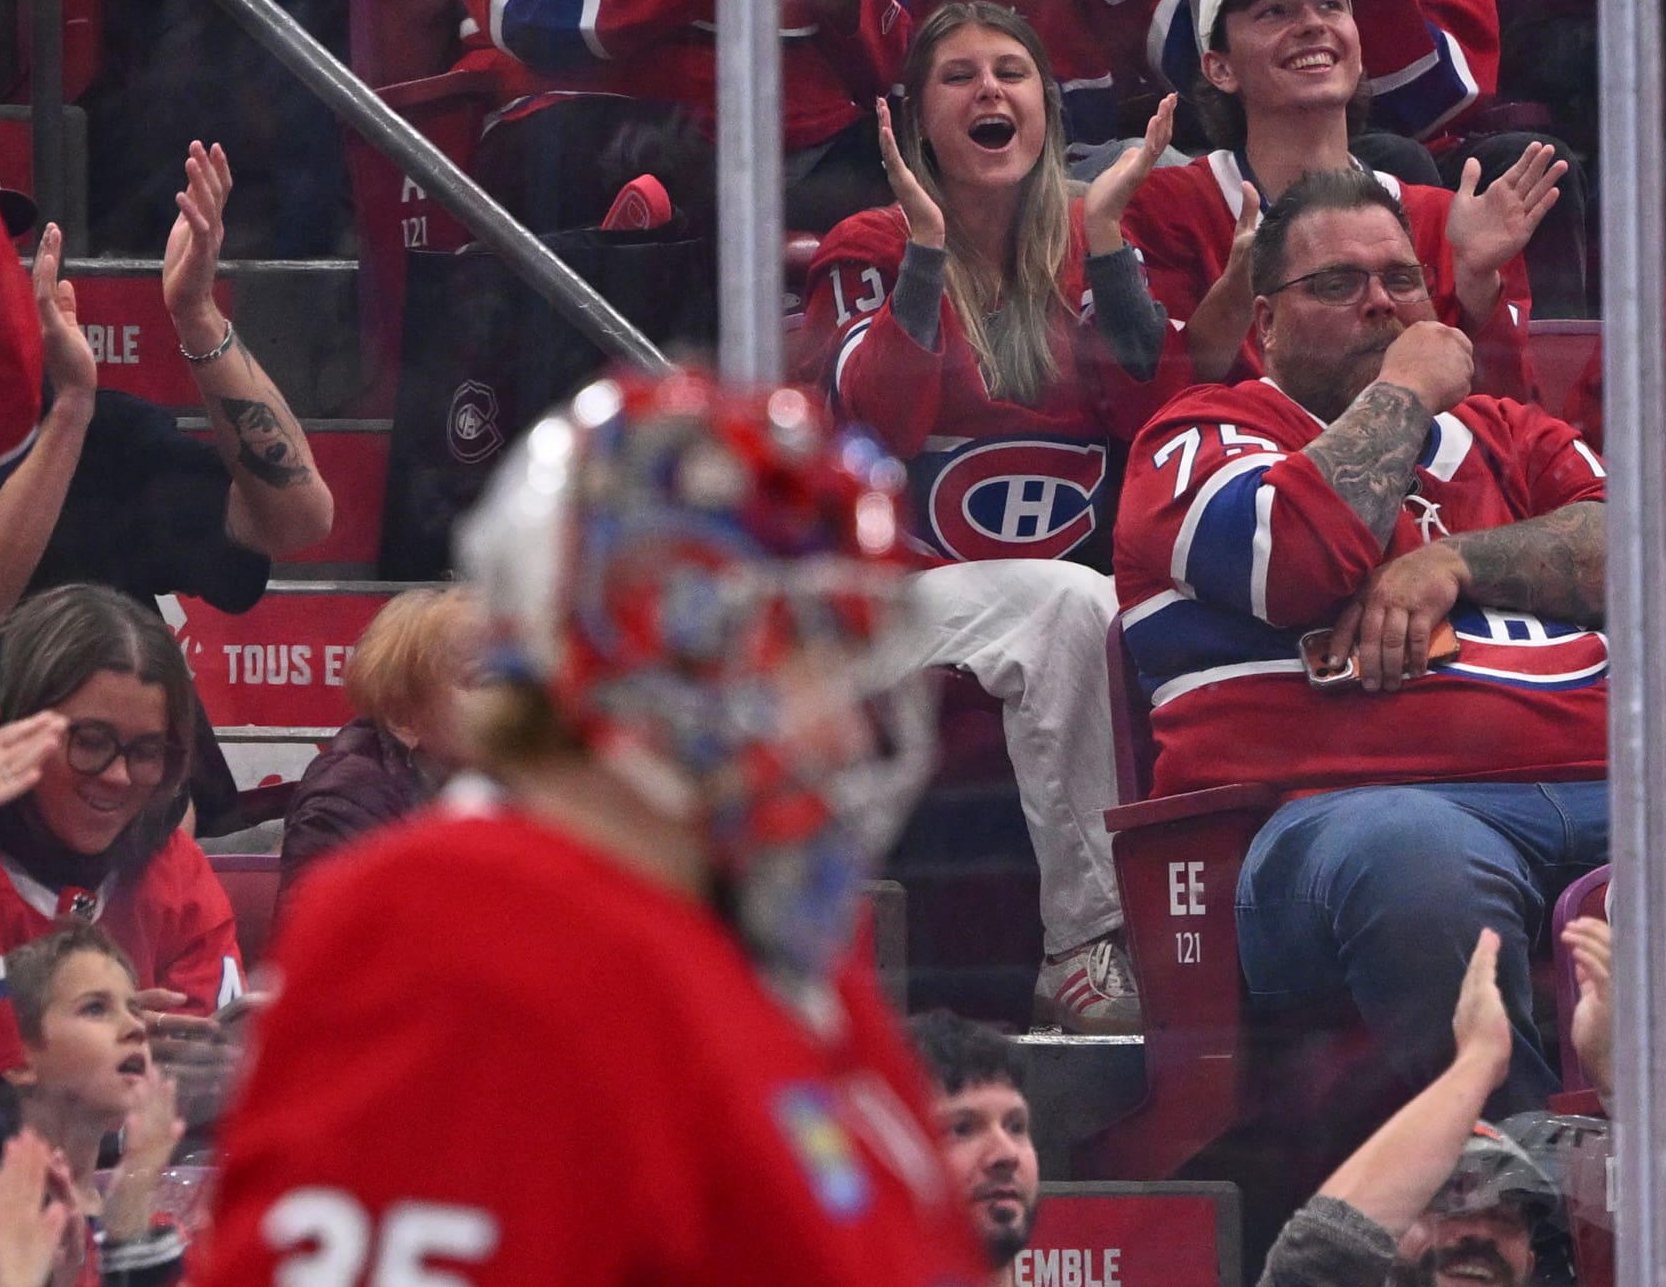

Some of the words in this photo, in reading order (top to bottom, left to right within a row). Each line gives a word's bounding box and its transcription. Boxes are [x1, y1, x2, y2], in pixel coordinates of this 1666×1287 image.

[222, 644, 312, 687] TOUS
[324, 644, 356, 687] E
[1169, 861, 1207, 916] EE
[1175, 931, 1202, 964] 121
